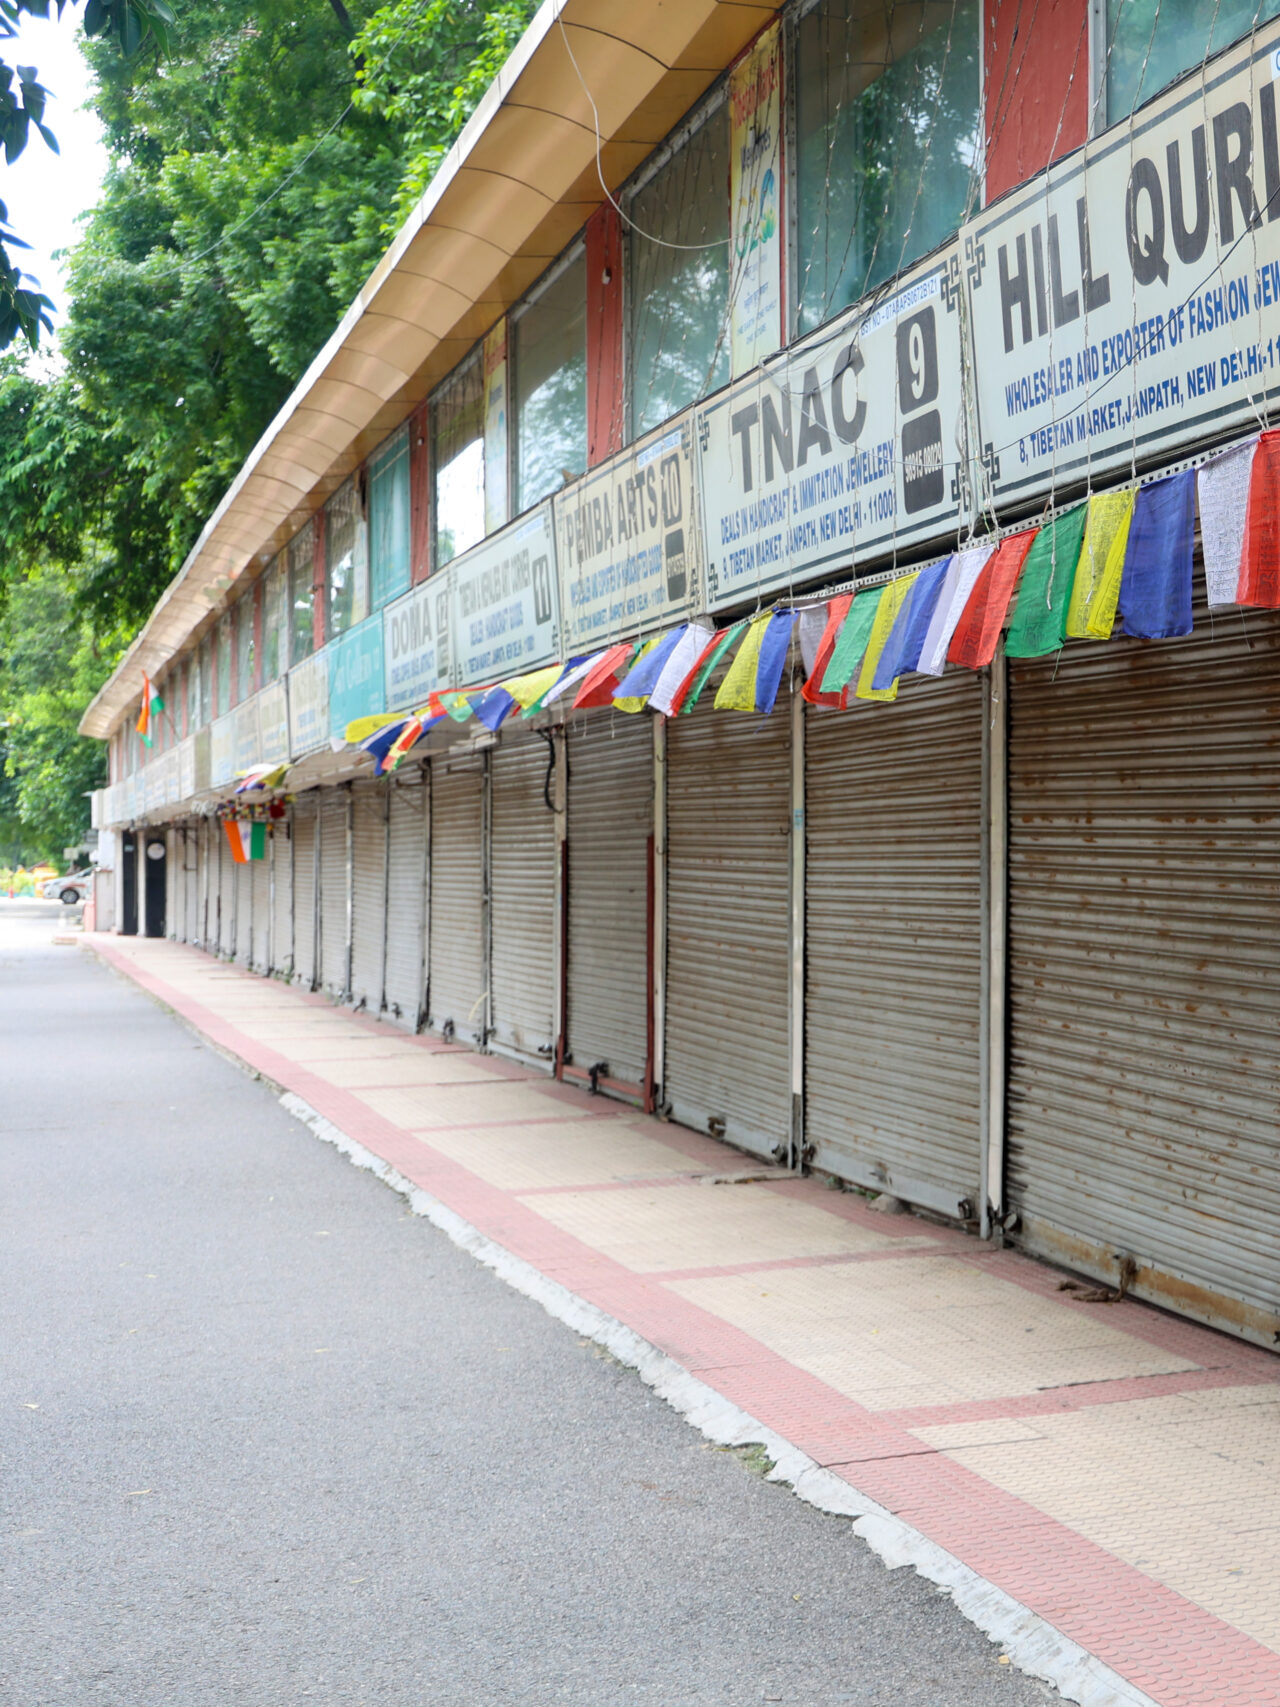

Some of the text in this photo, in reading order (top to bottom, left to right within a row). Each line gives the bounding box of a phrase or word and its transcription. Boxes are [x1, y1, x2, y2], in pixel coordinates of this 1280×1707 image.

[997, 196, 1111, 354] HILL
[908, 322, 925, 400] 9
[1005, 357, 1074, 417] WHOLESALER
[1077, 345, 1099, 387] AND
[1101, 315, 1165, 376] EXPORTER
[1168, 305, 1185, 347] OF
[1189, 275, 1250, 339] FASHION
[732, 344, 867, 494] TNAC
[1030, 418, 1074, 459] TIBETAN
[1187, 360, 1217, 399] NEW
[566, 465, 657, 568] PEMBA ARTS
[663, 459, 680, 520] 10
[721, 509, 740, 545] DEALS
[741, 506, 749, 536] IN
[846, 439, 894, 493] JEWELLERY
[730, 547, 755, 577] TIBETAN
[820, 511, 836, 542] NEW
[838, 501, 862, 536] DELHI
[391, 597, 432, 660] DOMA
[535, 558, 551, 620] 11
